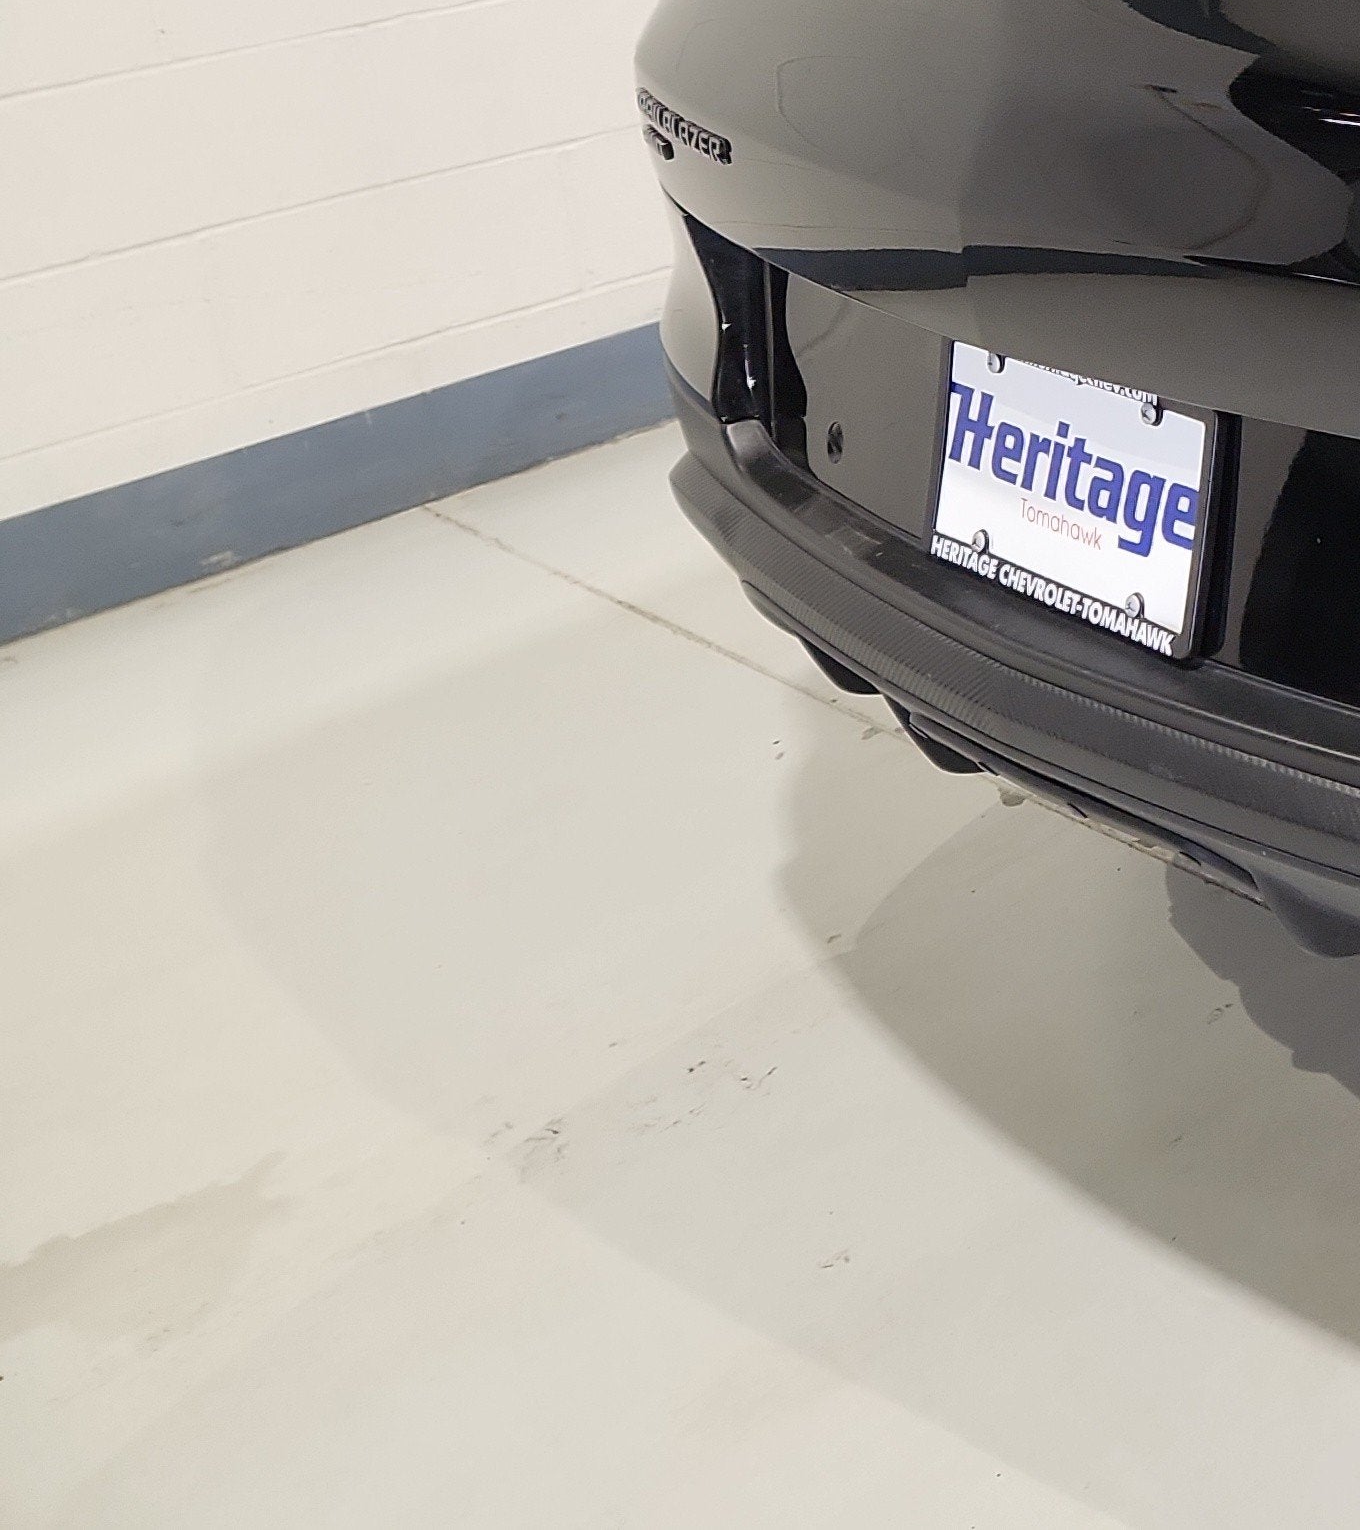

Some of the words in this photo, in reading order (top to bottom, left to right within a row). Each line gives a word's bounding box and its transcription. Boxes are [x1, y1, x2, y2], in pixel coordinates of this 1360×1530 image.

[949, 381, 1198, 558] Heritage
[1020, 497, 1102, 551] Tomahawk
[930, 535, 998, 580] HERITAGE
[998, 563, 1176, 657] CHEVROLET-TOMAHAWK
